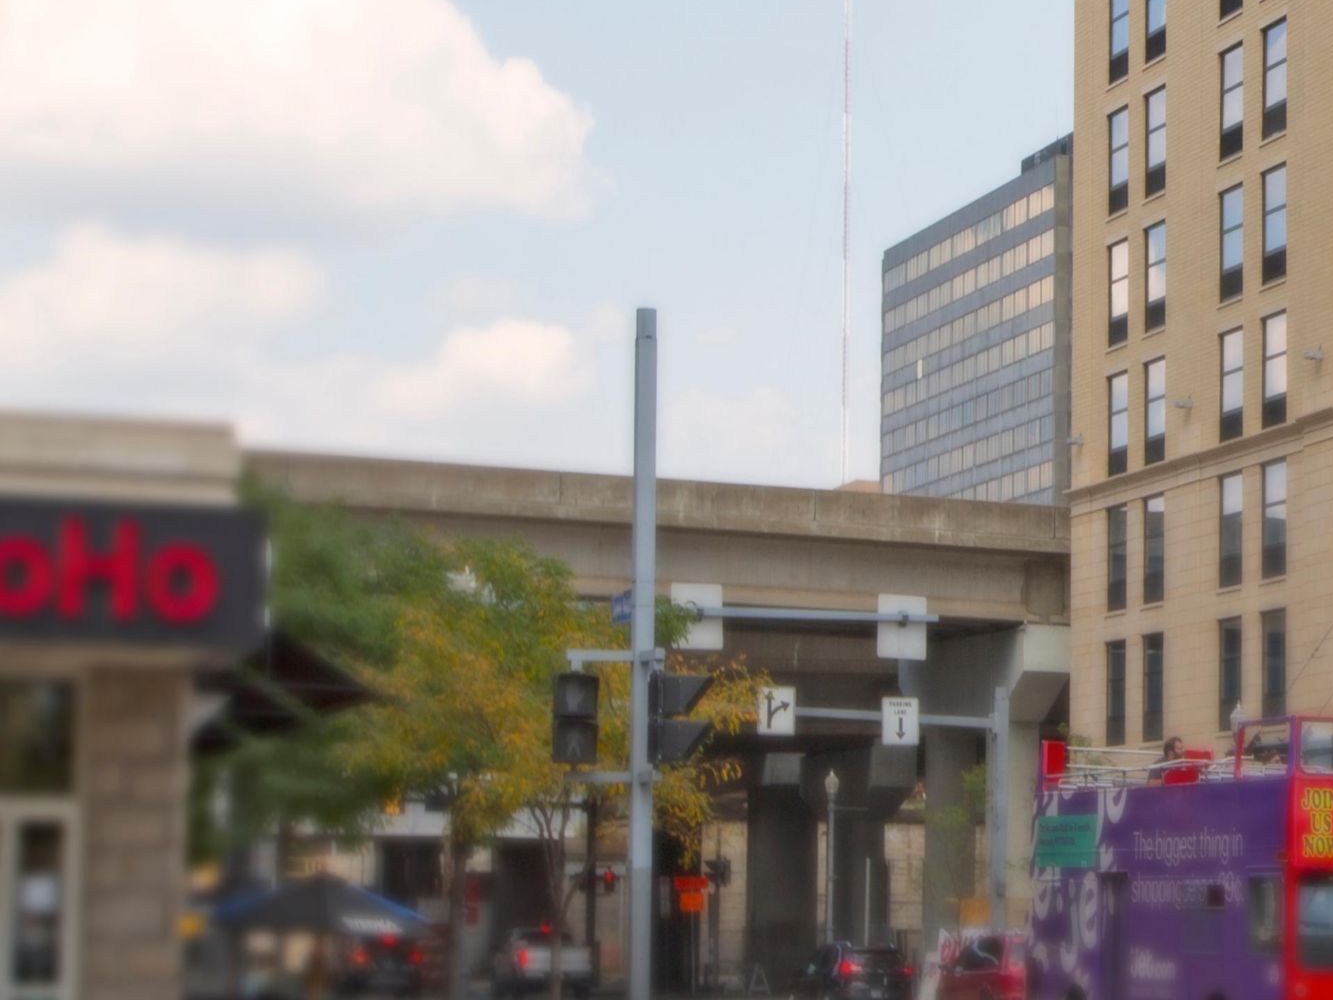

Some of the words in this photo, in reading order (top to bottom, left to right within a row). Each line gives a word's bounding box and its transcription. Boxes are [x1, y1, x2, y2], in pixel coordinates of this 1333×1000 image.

[1311, 811, 1333, 834] US
[1133, 830, 1153, 861] The
[1154, 828, 1198, 867] biggest
[1199, 825, 1231, 865] thing
[1231, 826, 1243, 857] in
